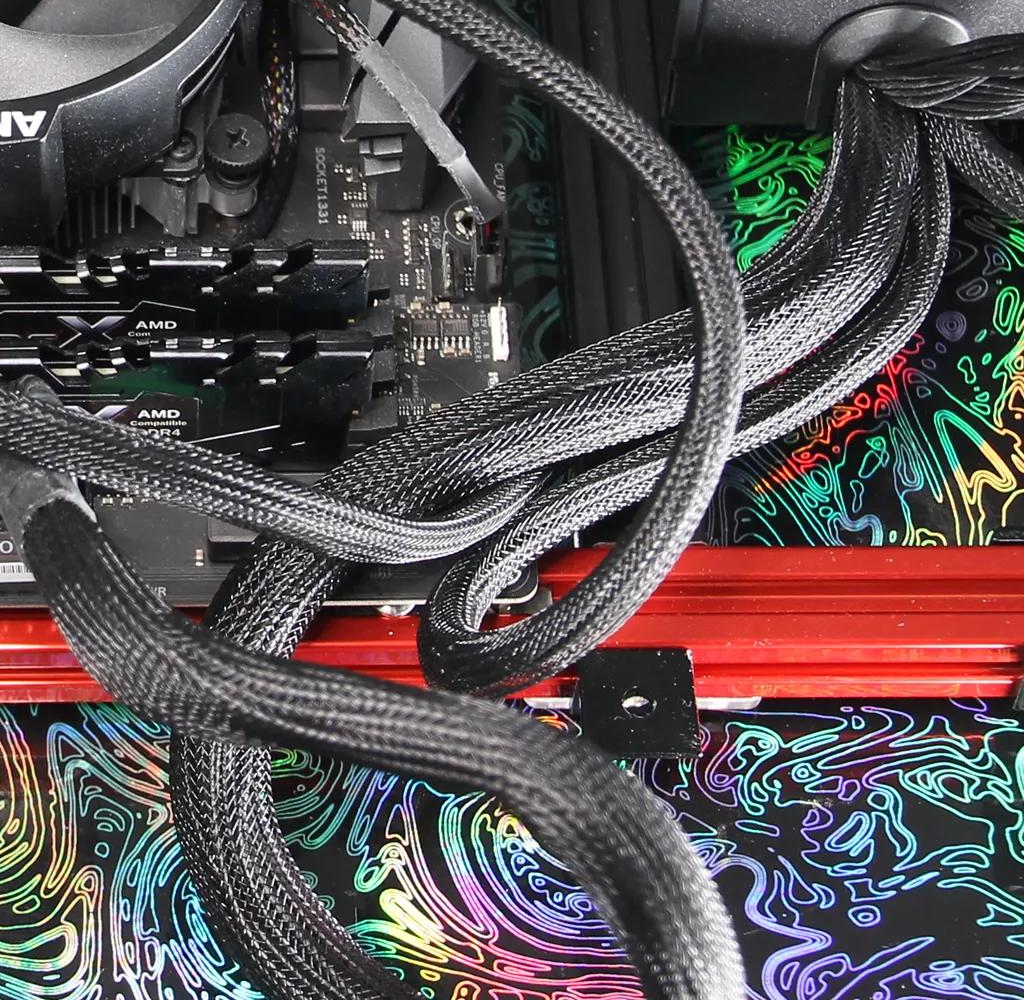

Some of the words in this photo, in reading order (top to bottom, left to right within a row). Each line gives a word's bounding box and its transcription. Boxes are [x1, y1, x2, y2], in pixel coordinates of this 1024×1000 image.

[315, 147, 330, 225] SOCKET1331
[136, 320, 178, 330] AMD
[137, 409, 181, 419] AMD
